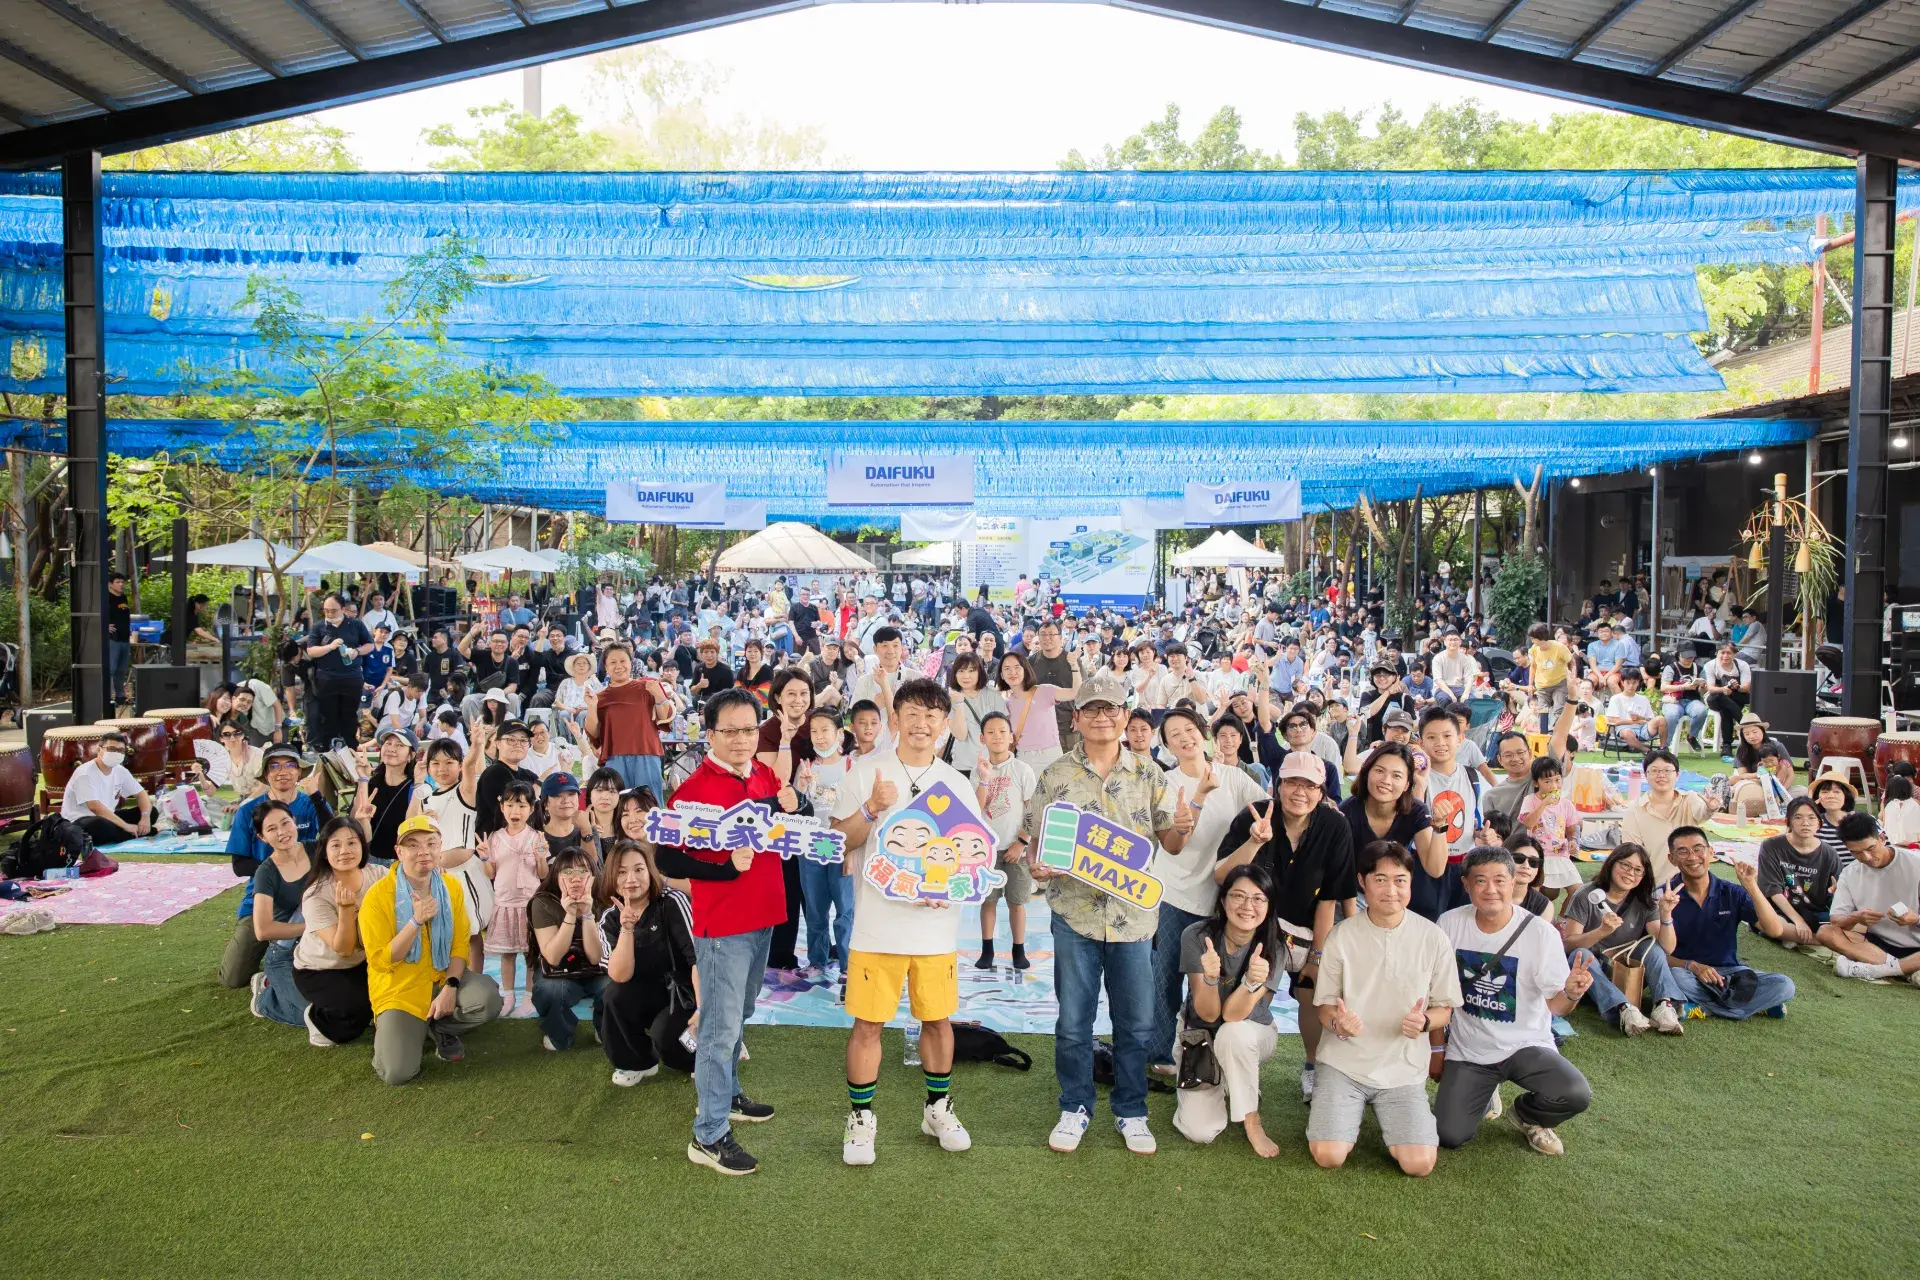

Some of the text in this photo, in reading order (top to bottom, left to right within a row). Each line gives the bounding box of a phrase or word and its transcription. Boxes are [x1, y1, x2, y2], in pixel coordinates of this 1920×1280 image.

[866, 466, 935, 480] DAIFUKU
[638, 491, 694, 503] DAIFUKU
[1214, 490, 1270, 505] DAIFUKU
[675, 803, 722, 814] Good Fortune
[781, 816, 804, 825] Family
[647, 803, 844, 862] 福氣家年華
[1087, 824, 1134, 860] 福氣
[868, 857, 1000, 899] 福氣一家人
[1078, 855, 1147, 900] MAX!
[1465, 993, 1507, 1012] adidas
